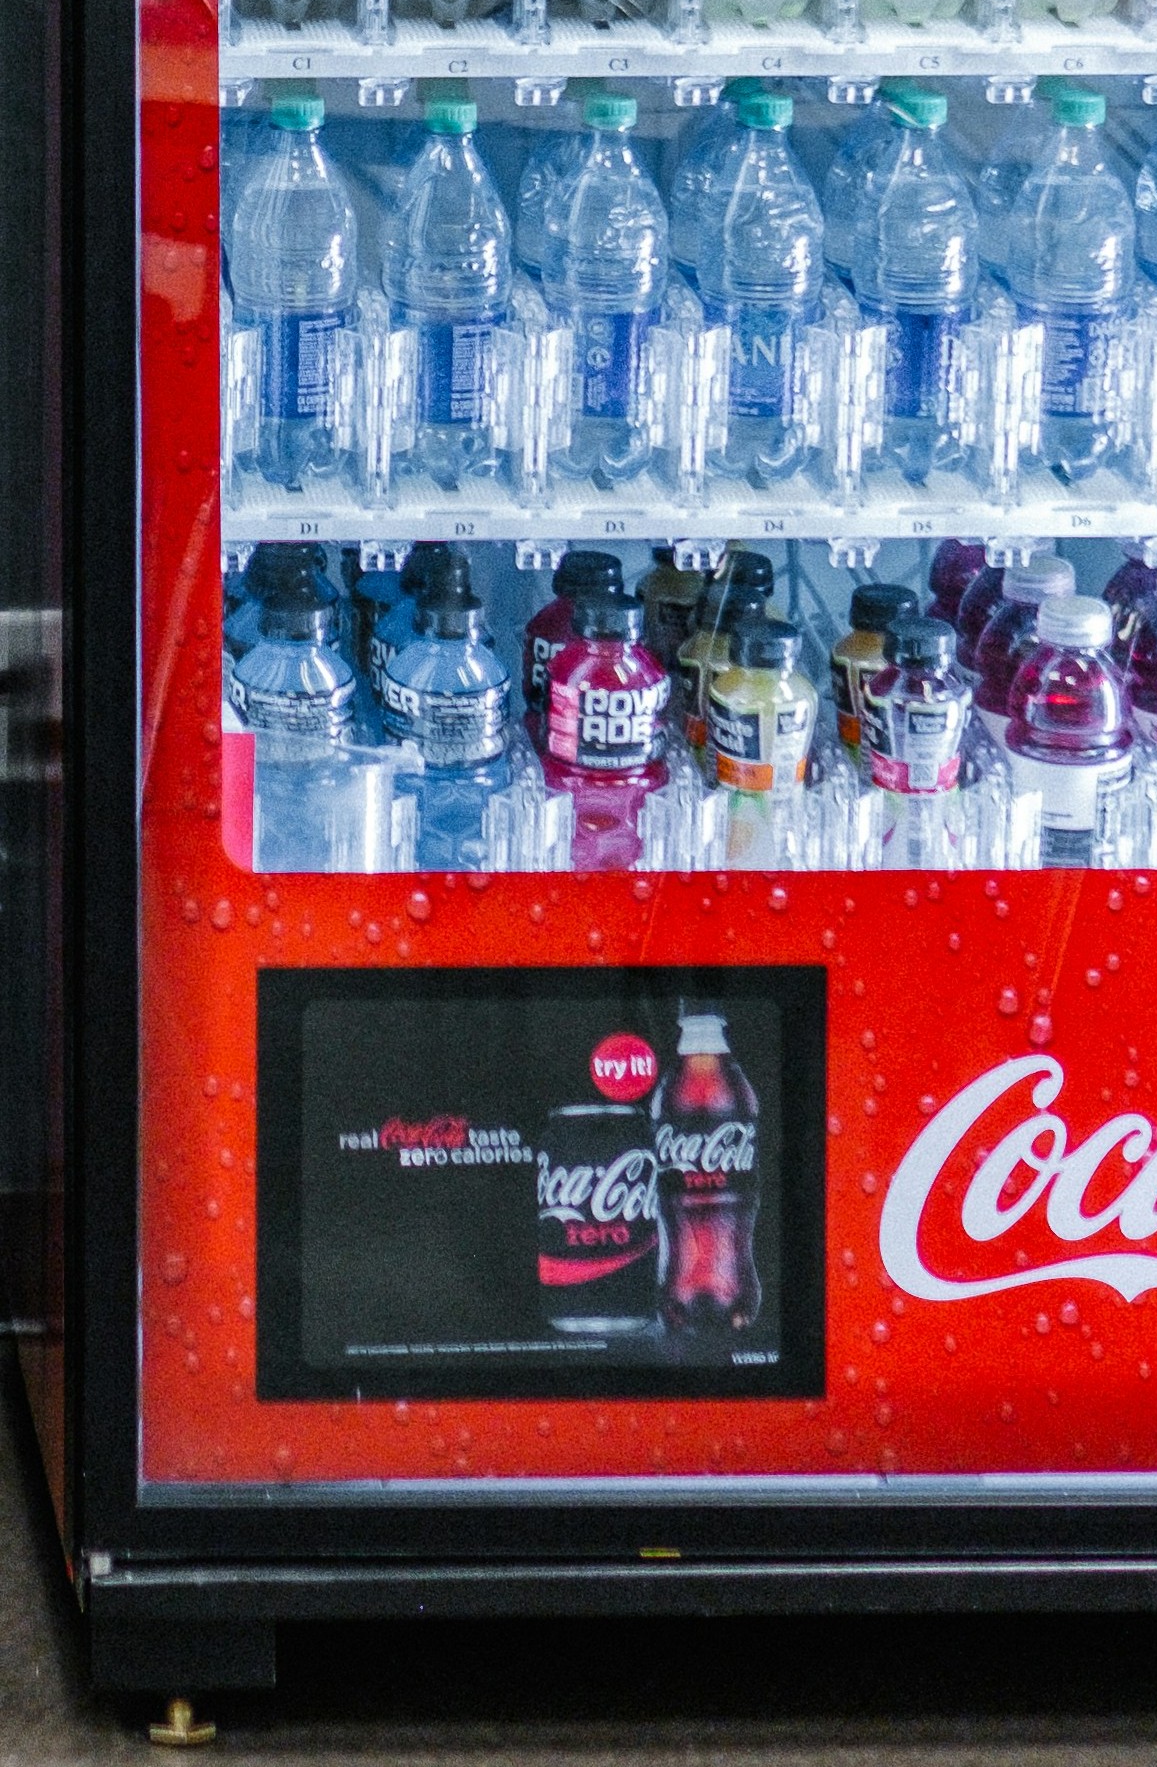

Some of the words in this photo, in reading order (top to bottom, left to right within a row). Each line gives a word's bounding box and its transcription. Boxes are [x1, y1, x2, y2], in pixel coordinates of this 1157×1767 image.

[292, 57, 312, 70] C1
[448, 61, 468, 73] C2
[608, 58, 628, 70] C3
[762, 57, 782, 70] C4
[919, 57, 940, 70] C5
[1063, 58, 1083, 70] C6
[301, 522, 319, 534] D1
[455, 522, 475, 535] D2
[605, 520, 625, 533] D3
[764, 521, 784, 532] D4
[912, 521, 933, 532] D5
[594, 1057, 627, 1079] try
[339, 1128, 378, 1149] real
[469, 1128, 520, 1146] taste
[400, 1147, 448, 1166] zero
[451, 1143, 533, 1164] calories
